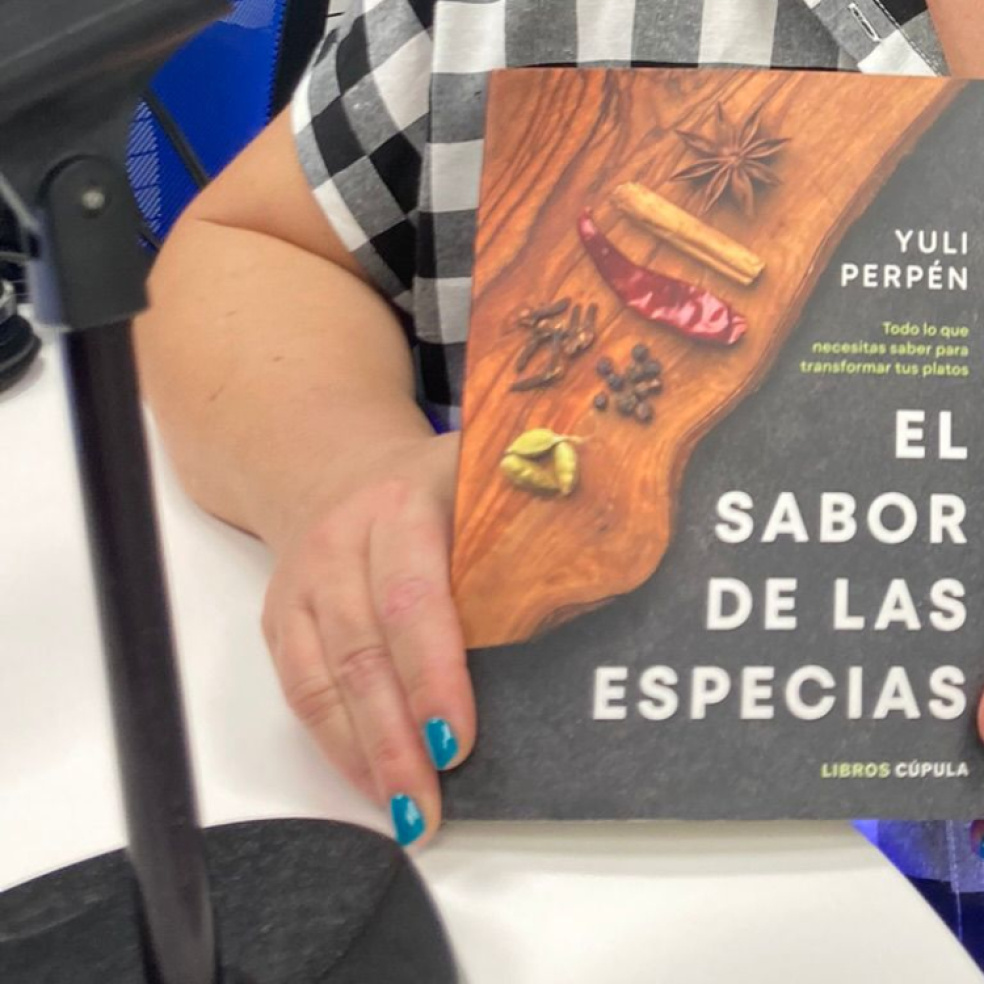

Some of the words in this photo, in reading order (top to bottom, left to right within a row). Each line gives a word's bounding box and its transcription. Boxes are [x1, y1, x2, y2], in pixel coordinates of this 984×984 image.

[894, 229, 968, 255] YULI
[840, 259, 968, 291] PERPÉN
[883, 321, 920, 336] Todo
[923, 322, 938, 337] lo
[940, 326, 969, 339] que
[812, 340, 887, 355] necesitas
[890, 341, 932, 356] saber
[935, 344, 969, 358] para
[800, 360, 892, 374] transformar
[895, 362, 919, 375] tus
[922, 362, 969, 378] platos
[895, 409, 968, 459] EL
[714, 490, 968, 544] SABOR
[706, 577, 798, 630] DE
[833, 577, 968, 632] LAS
[593, 665, 968, 720] ESPECIAS
[821, 762, 891, 778] LIBROS
[895, 758, 969, 778] CÚPULA
